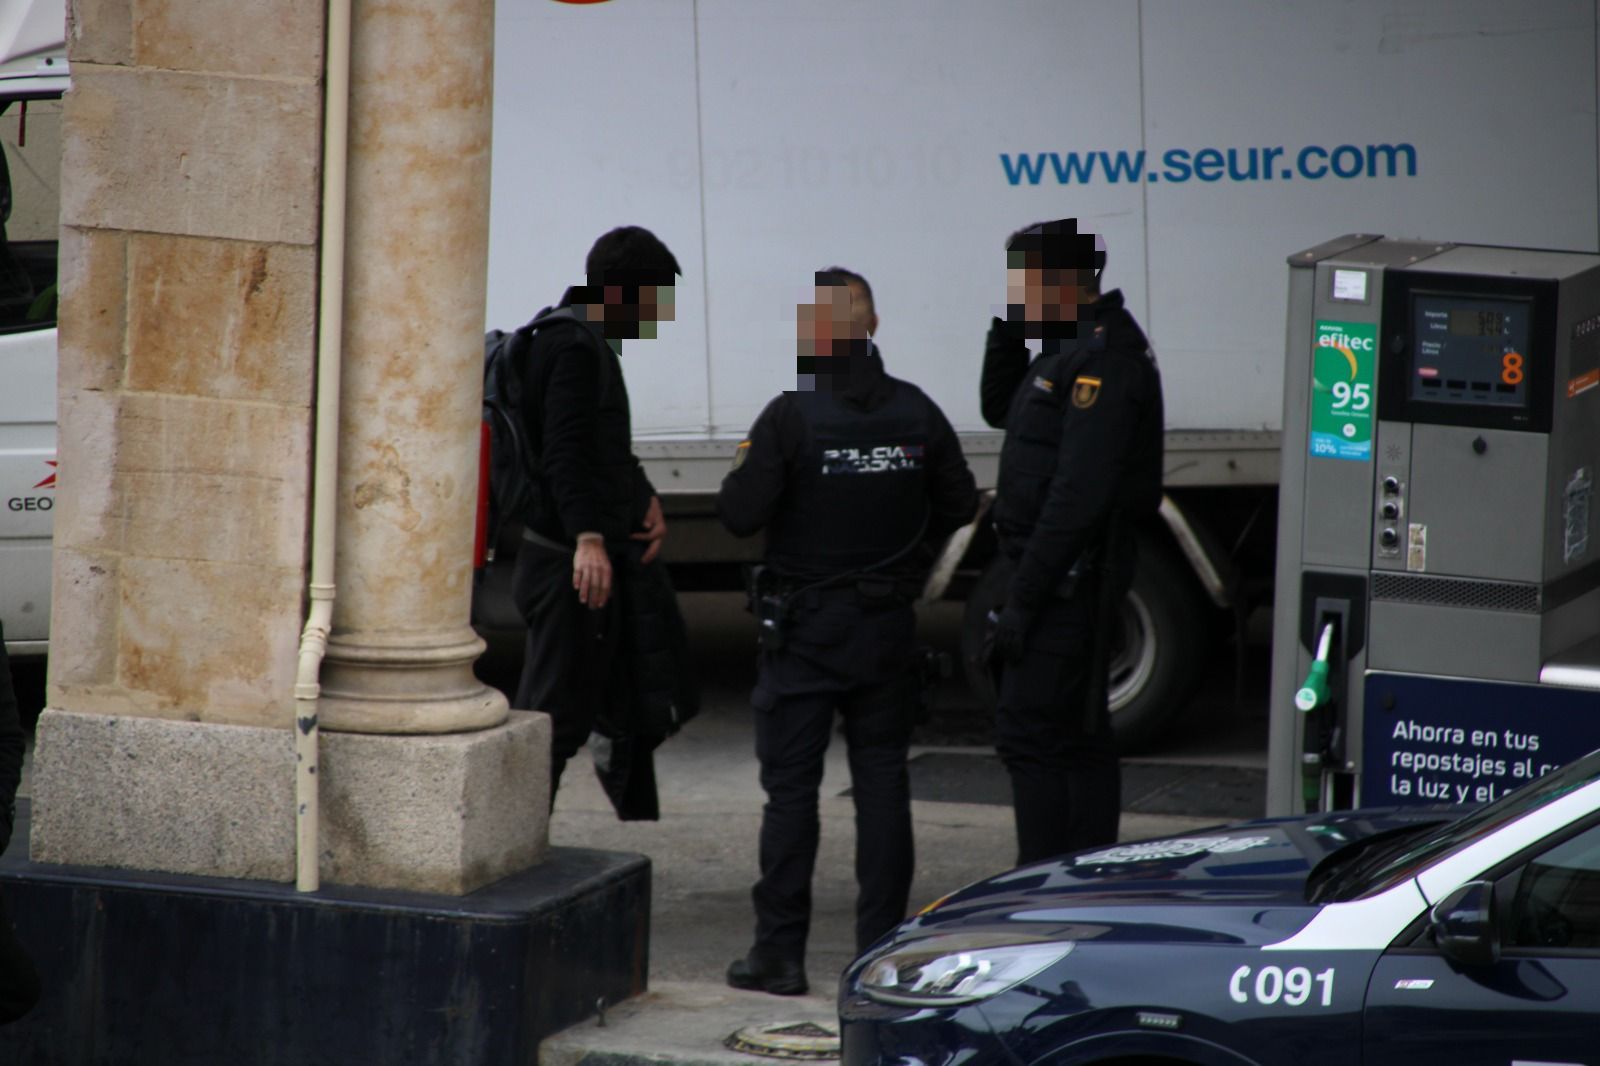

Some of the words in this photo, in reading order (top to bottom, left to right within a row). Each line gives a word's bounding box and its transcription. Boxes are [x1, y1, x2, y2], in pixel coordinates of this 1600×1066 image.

[1000, 142, 1417, 185] www.seur.com
[1318, 332, 1373, 351] efitec
[1502, 353, 1523, 384] 8
[1331, 381, 1370, 410] 95
[8, 497, 55, 511] GEO
[1392, 720, 1465, 745] Ahorra
[1471, 730, 1497, 747] en
[1504, 729, 1540, 751] tus
[1391, 751, 1506, 779] repostajes
[1512, 758, 1534, 778] al
[1390, 774, 1411, 796] la
[1418, 776, 1450, 799] luz
[1456, 785, 1469, 805] y
[1475, 782, 1496, 802] el
[1255, 966, 1335, 1006] 091
